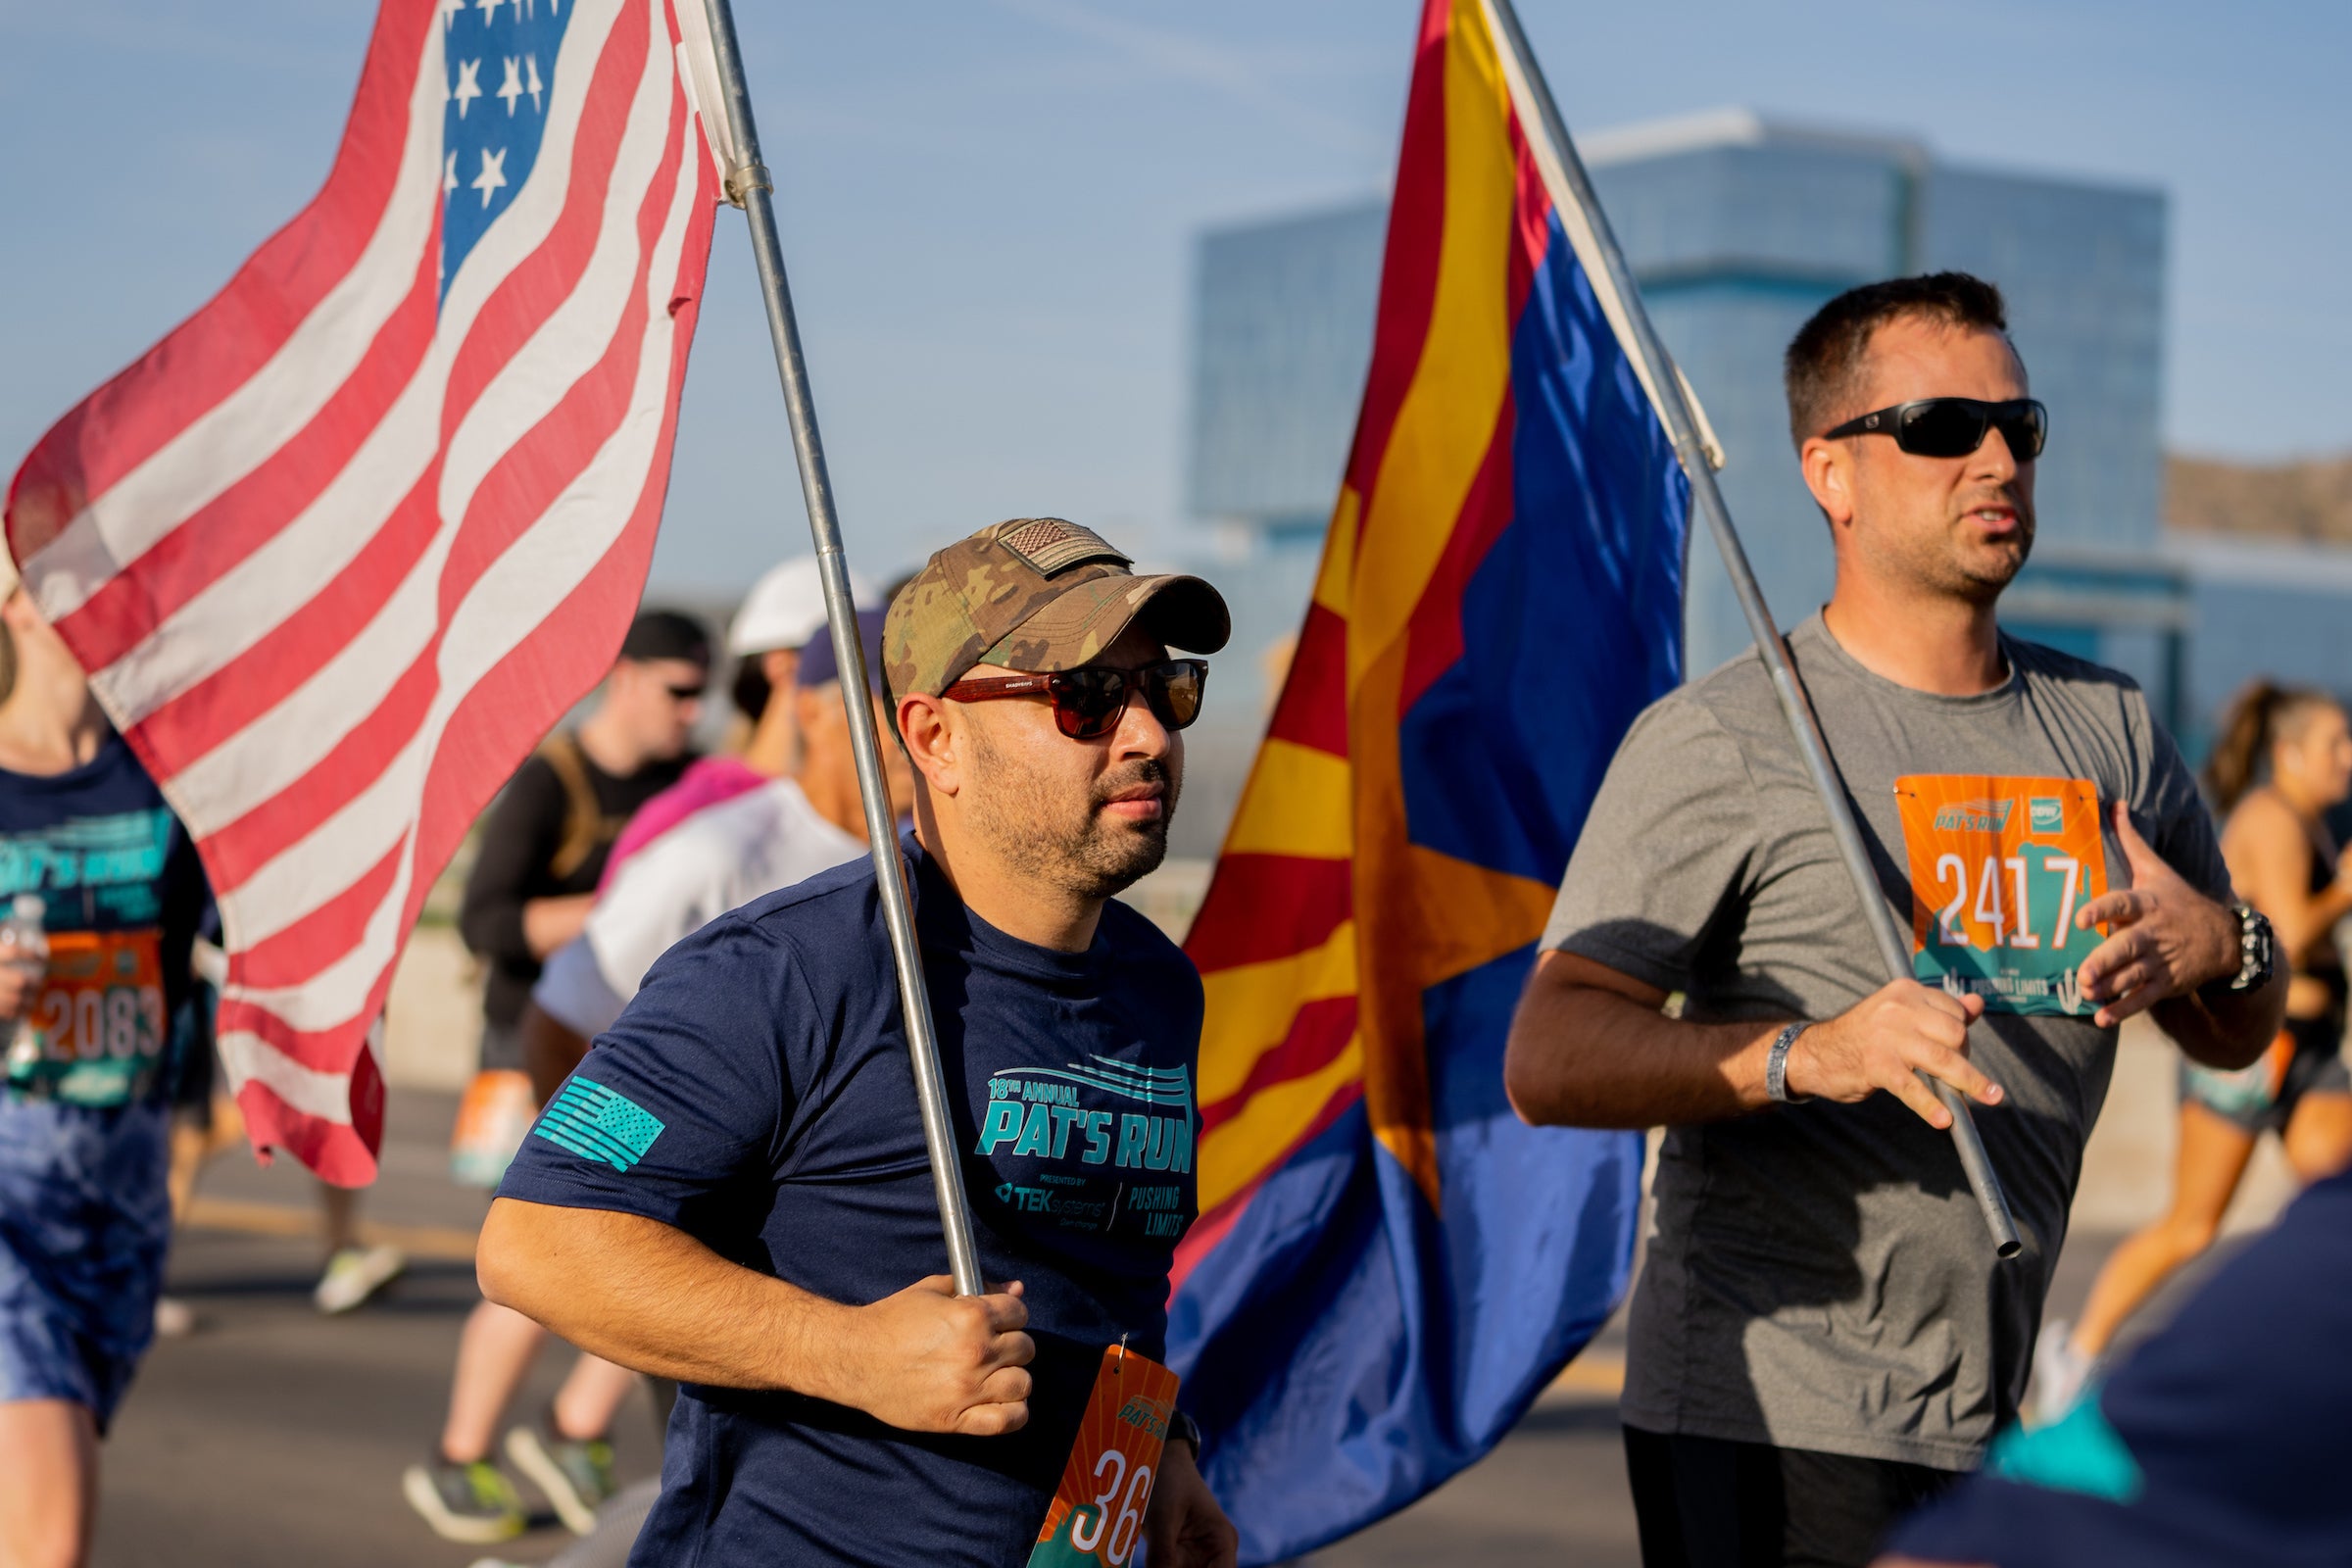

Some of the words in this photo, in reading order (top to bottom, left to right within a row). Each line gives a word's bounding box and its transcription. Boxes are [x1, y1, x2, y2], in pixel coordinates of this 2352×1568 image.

[1934, 814, 1976, 831] PAT'S
[1936, 853, 2079, 949] 2417
[2015, 978, 2049, 996] LIMITS
[987, 1078, 1021, 1101] 18TH
[1022, 1081, 1080, 1107] ANNUAL
[974, 1100, 1113, 1165] PAT'S
[1115, 1113, 1193, 1174] RUN
[1039, 1173, 1076, 1186] PRESENTED
[1076, 1177, 1087, 1187] BY
[1128, 1186, 1181, 1210] PUSHING
[1145, 1212, 1184, 1238] LIMITS
[1117, 1403, 1158, 1435] PAT'S
[1072, 1449, 1152, 1566] 36
